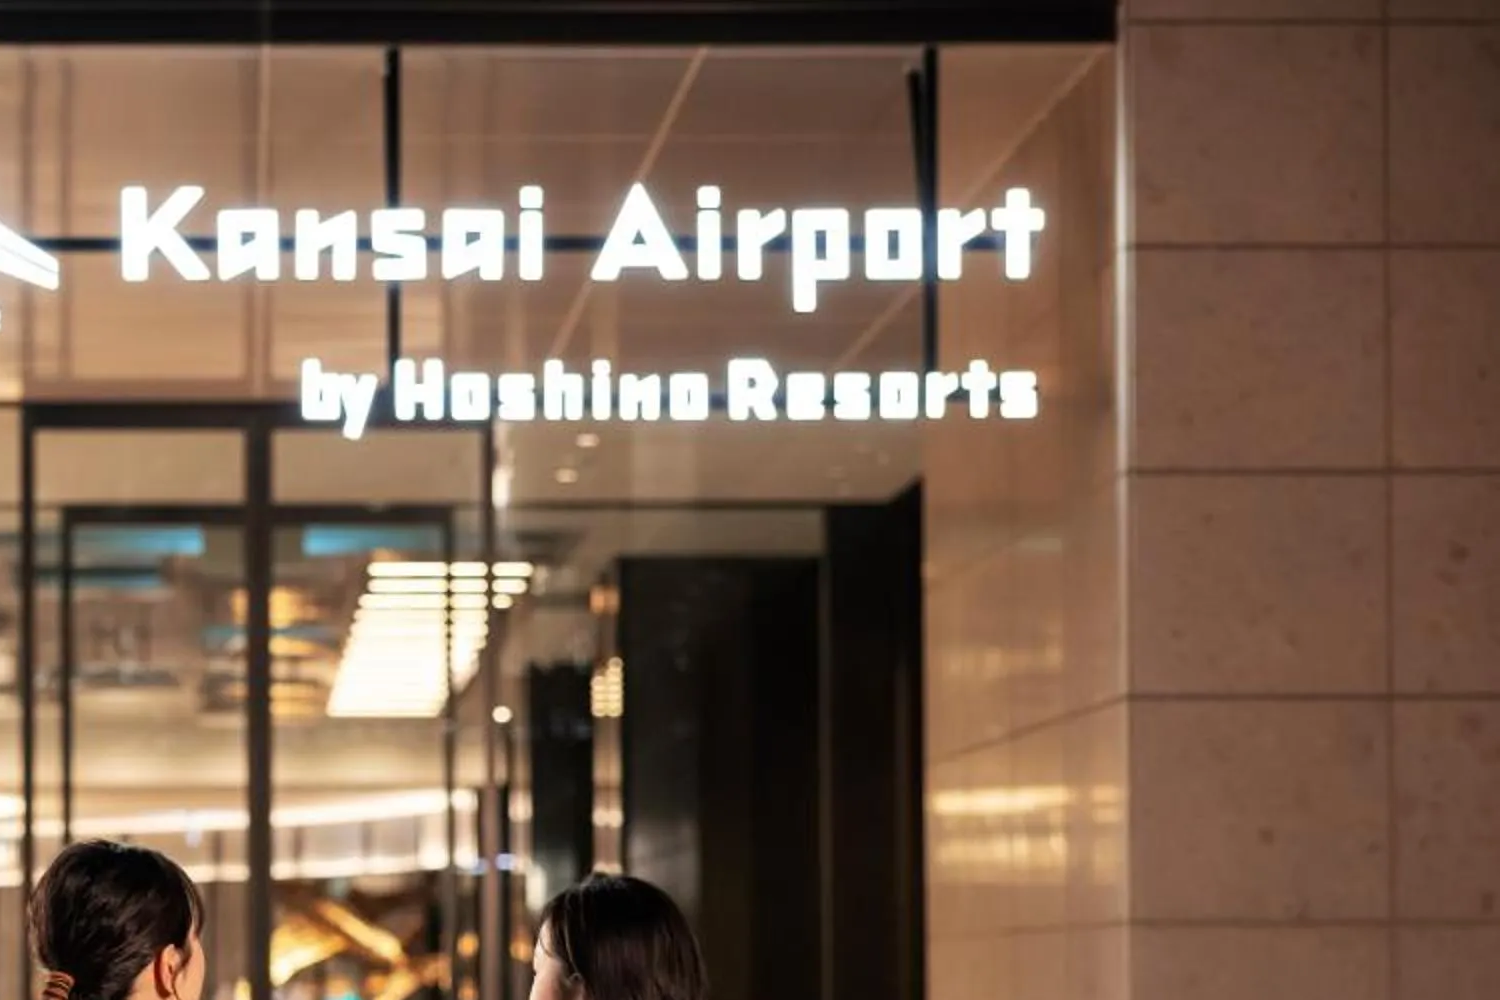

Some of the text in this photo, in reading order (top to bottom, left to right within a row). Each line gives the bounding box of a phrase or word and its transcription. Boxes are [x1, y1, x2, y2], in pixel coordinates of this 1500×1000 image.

[119, 185, 544, 282] Kansai
[590, 183, 1045, 313] Airport
[300, 358, 1038, 439] by Hoshino Resorts
